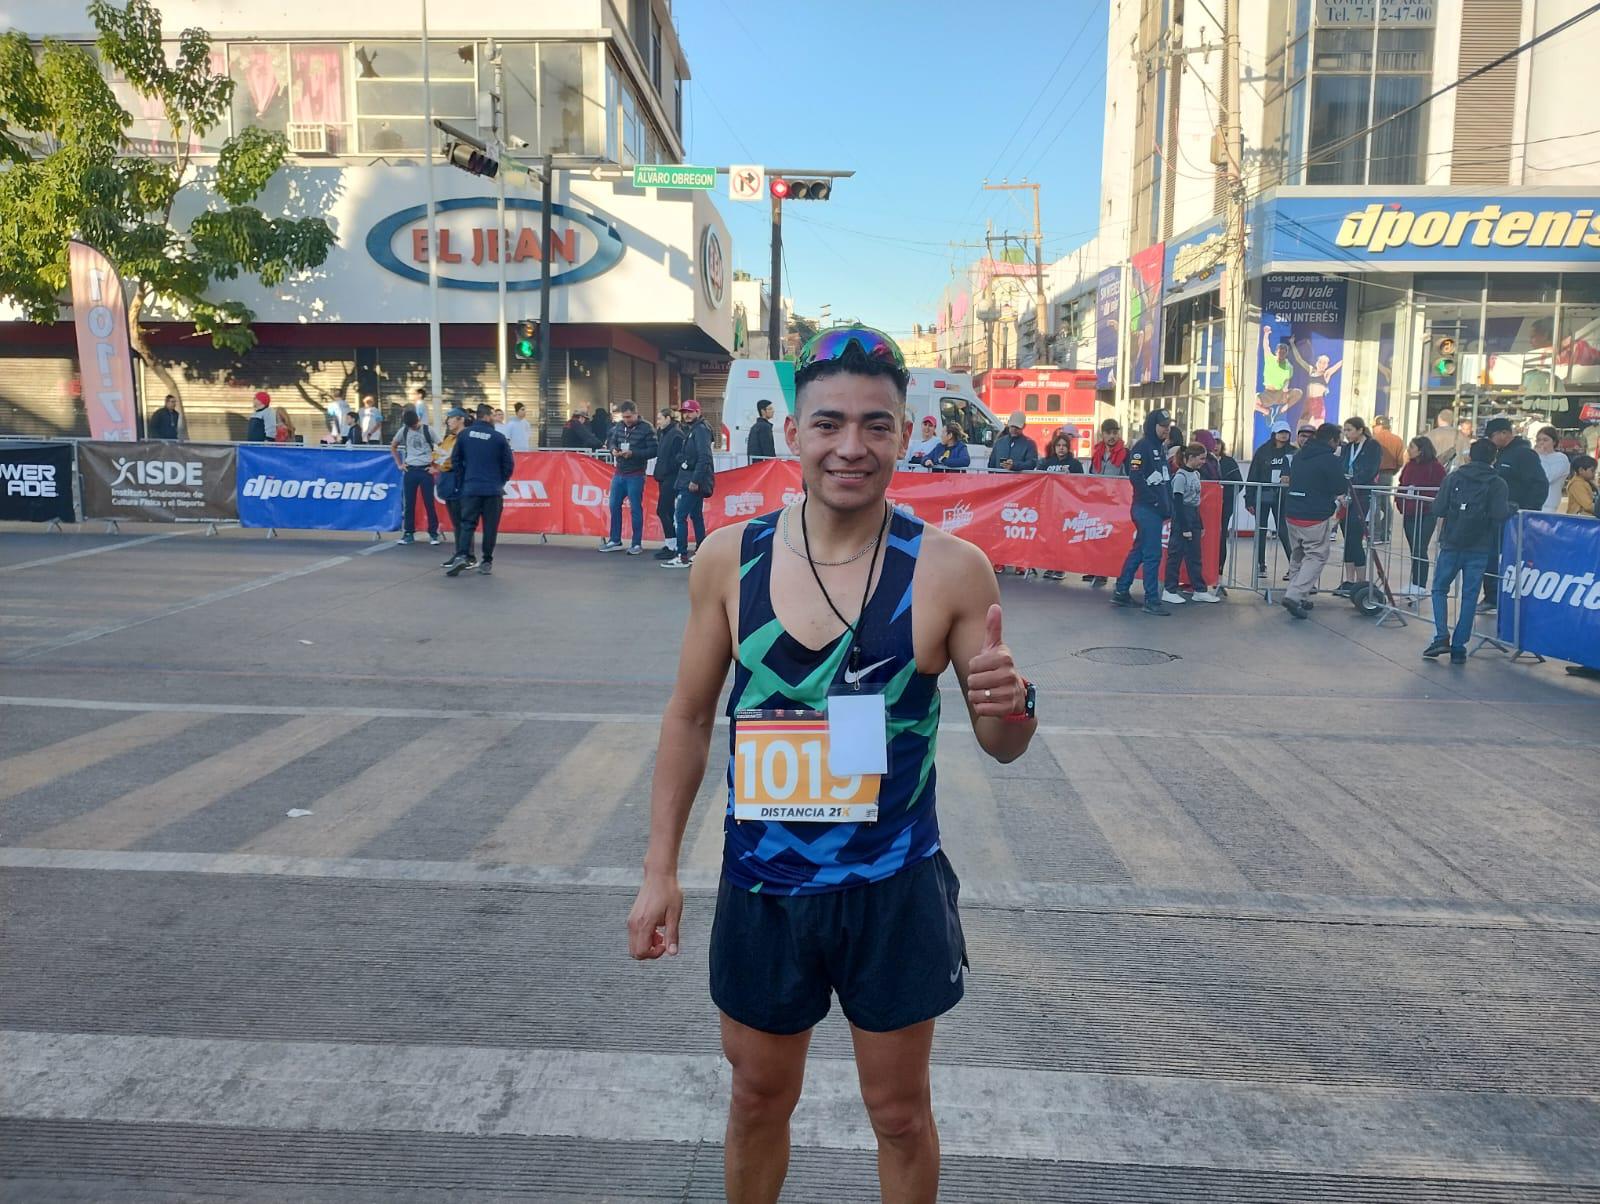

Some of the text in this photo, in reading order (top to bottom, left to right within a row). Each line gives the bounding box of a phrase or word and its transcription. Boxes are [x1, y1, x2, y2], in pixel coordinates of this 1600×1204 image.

[637, 171, 713, 186] ALVARO OBREGON
[413, 228, 576, 266] EL JEAN
[1275, 310, 1338, 323] SIN INTERÉS!
[0, 464, 56, 480] WER
[8, 480, 57, 497] ADE
[1003, 525, 1037, 541] 101.7
[761, 807, 825, 817] DISTANCIA
